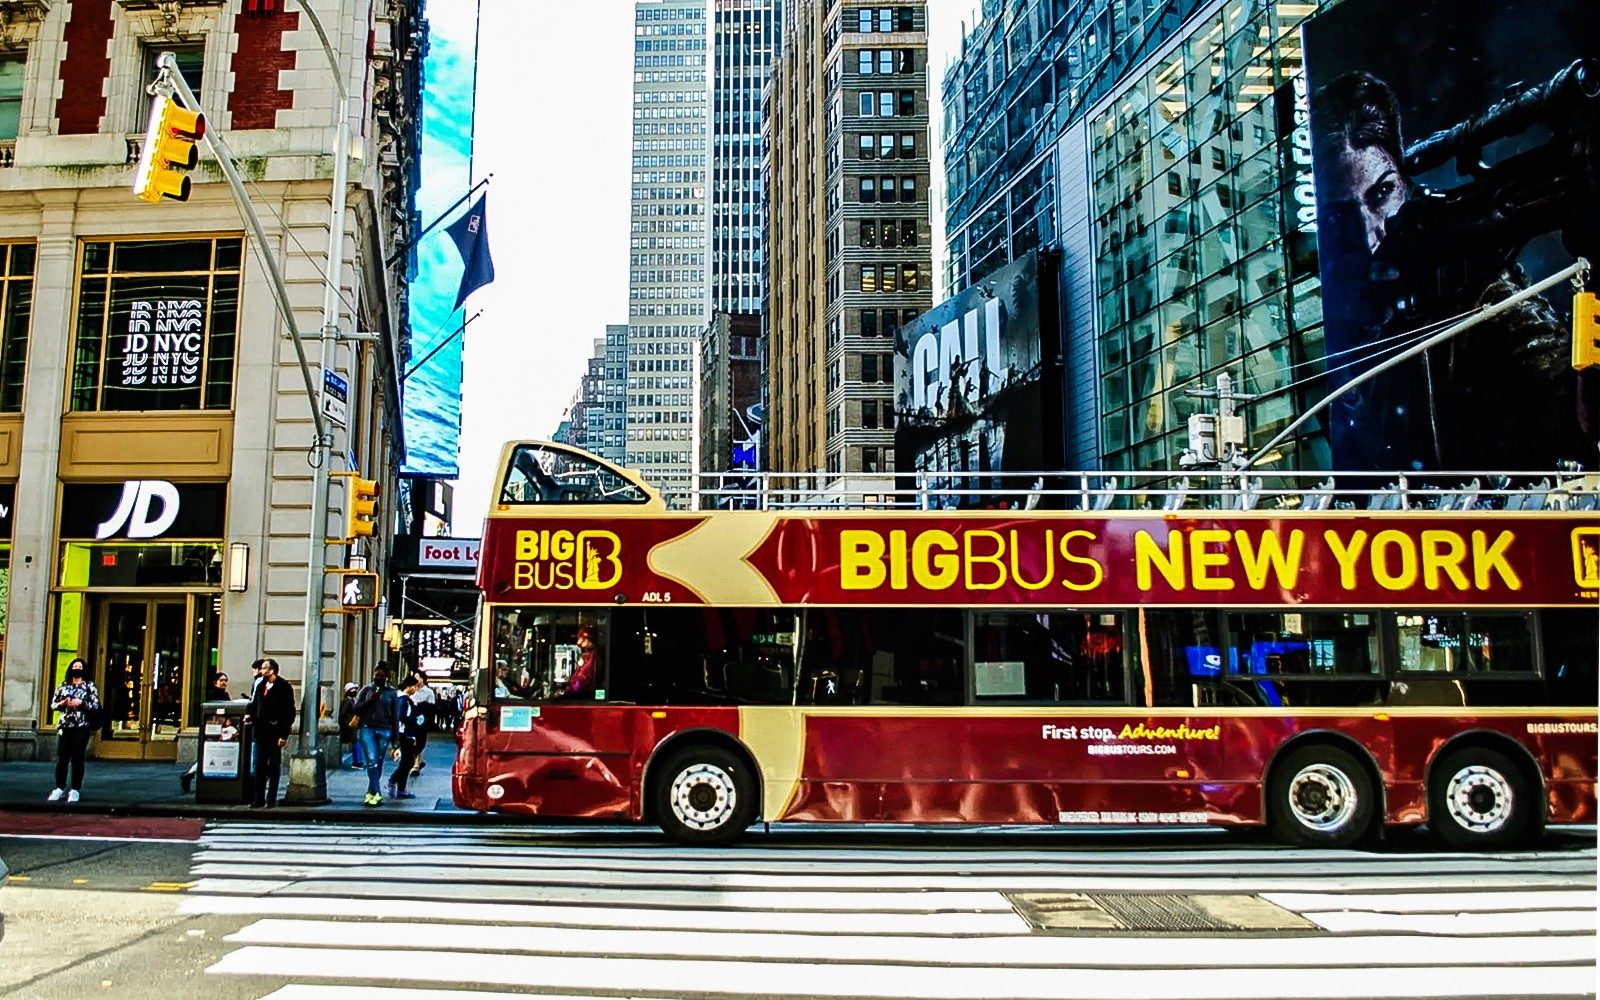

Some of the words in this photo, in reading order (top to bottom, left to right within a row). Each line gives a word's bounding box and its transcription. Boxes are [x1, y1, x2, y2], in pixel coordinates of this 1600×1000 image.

[122, 334, 149, 353] JD
[154, 333, 202, 352] NYC
[913, 296, 1009, 414] CALL
[95, 480, 180, 538] JD
[424, 545, 461, 561] Foot
[515, 530, 575, 561] BIG
[840, 529, 1104, 592] BIGBUS
[1133, 529, 1306, 592] NEW
[1323, 529, 1522, 592] YORK
[514, 562, 574, 590] BUS
[641, 591, 663, 602] ADL
[663, 591, 672, 602] 5
[1041, 724, 1078, 740] First
[1080, 724, 1117, 742] stop.
[1117, 722, 1221, 740] Adventure!
[1087, 744, 1177, 755] BIGBUSTOURS.COM
